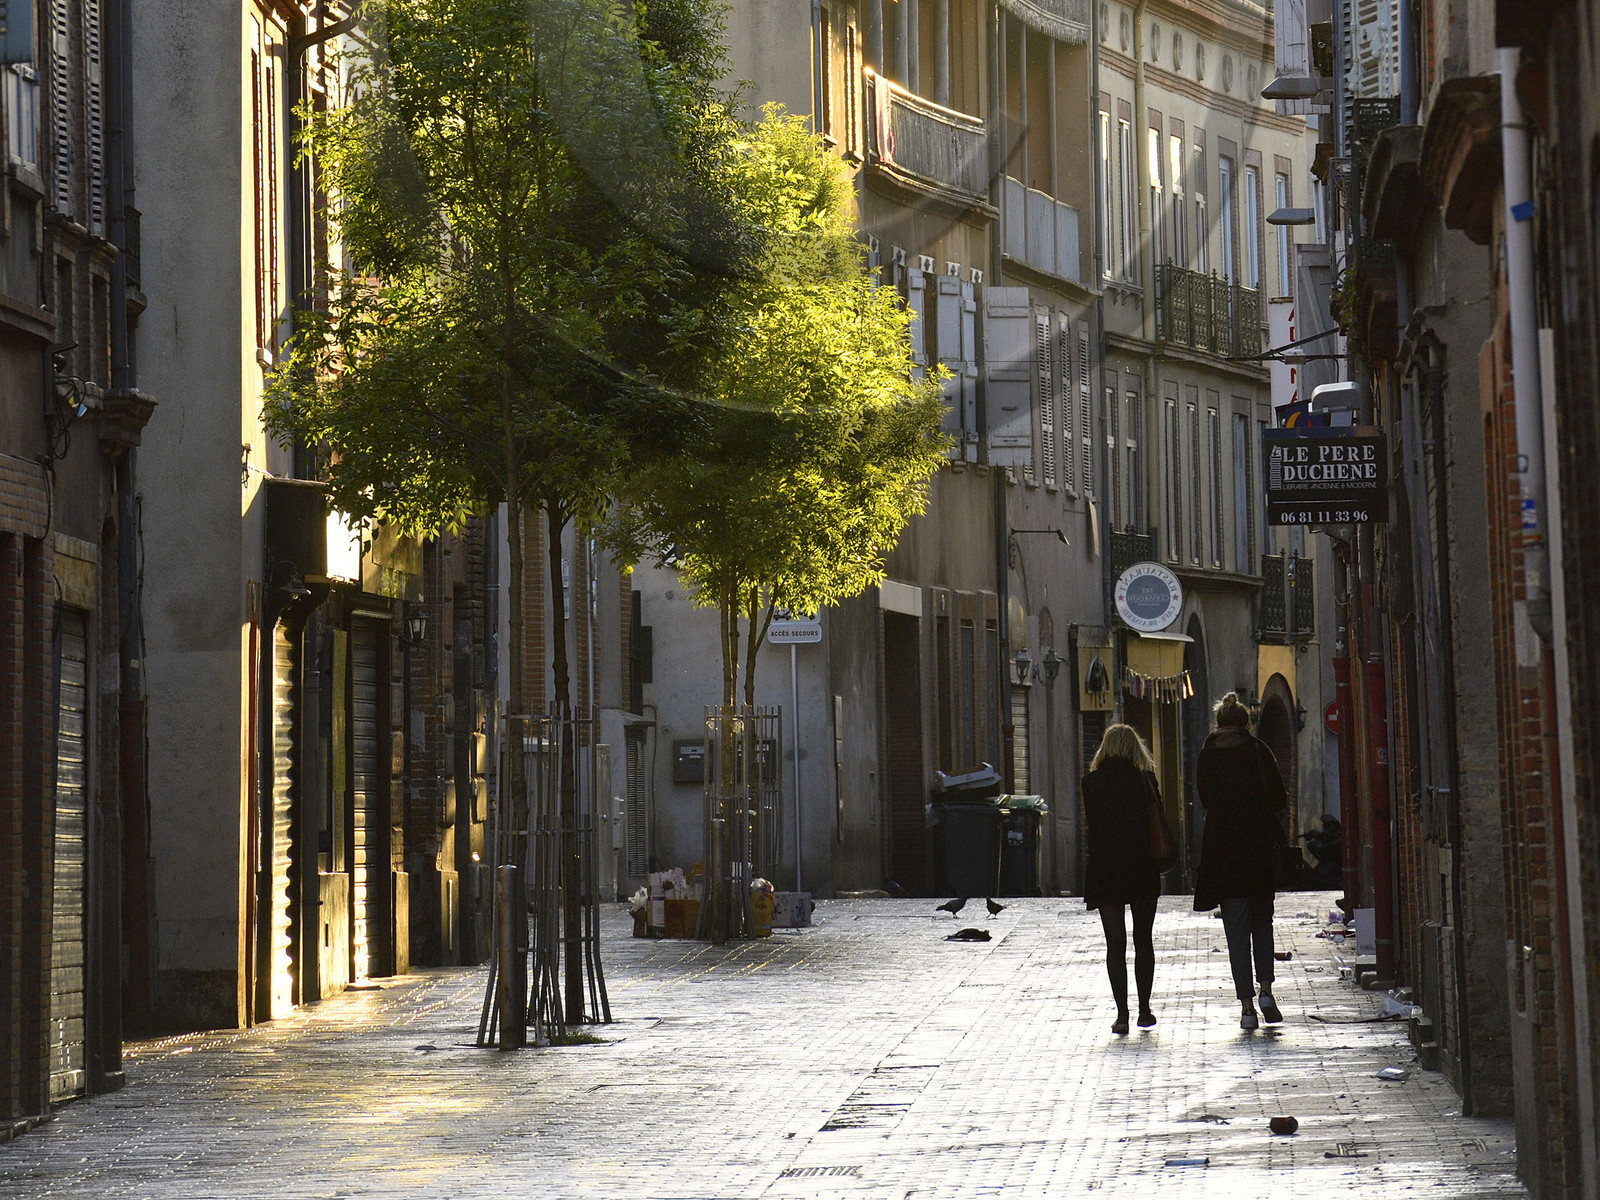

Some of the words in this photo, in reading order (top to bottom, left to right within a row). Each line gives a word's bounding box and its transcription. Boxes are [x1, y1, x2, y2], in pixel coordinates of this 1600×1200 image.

[1282, 446, 1309, 462] LE
[1318, 445, 1375, 462] PERE
[1283, 463, 1377, 480] DUCHENE
[1281, 512, 1296, 523] 06
[1299, 511, 1313, 523] 81
[1317, 511, 1331, 523] 11
[1335, 511, 1350, 522] 33
[1353, 510, 1368, 522] 96
